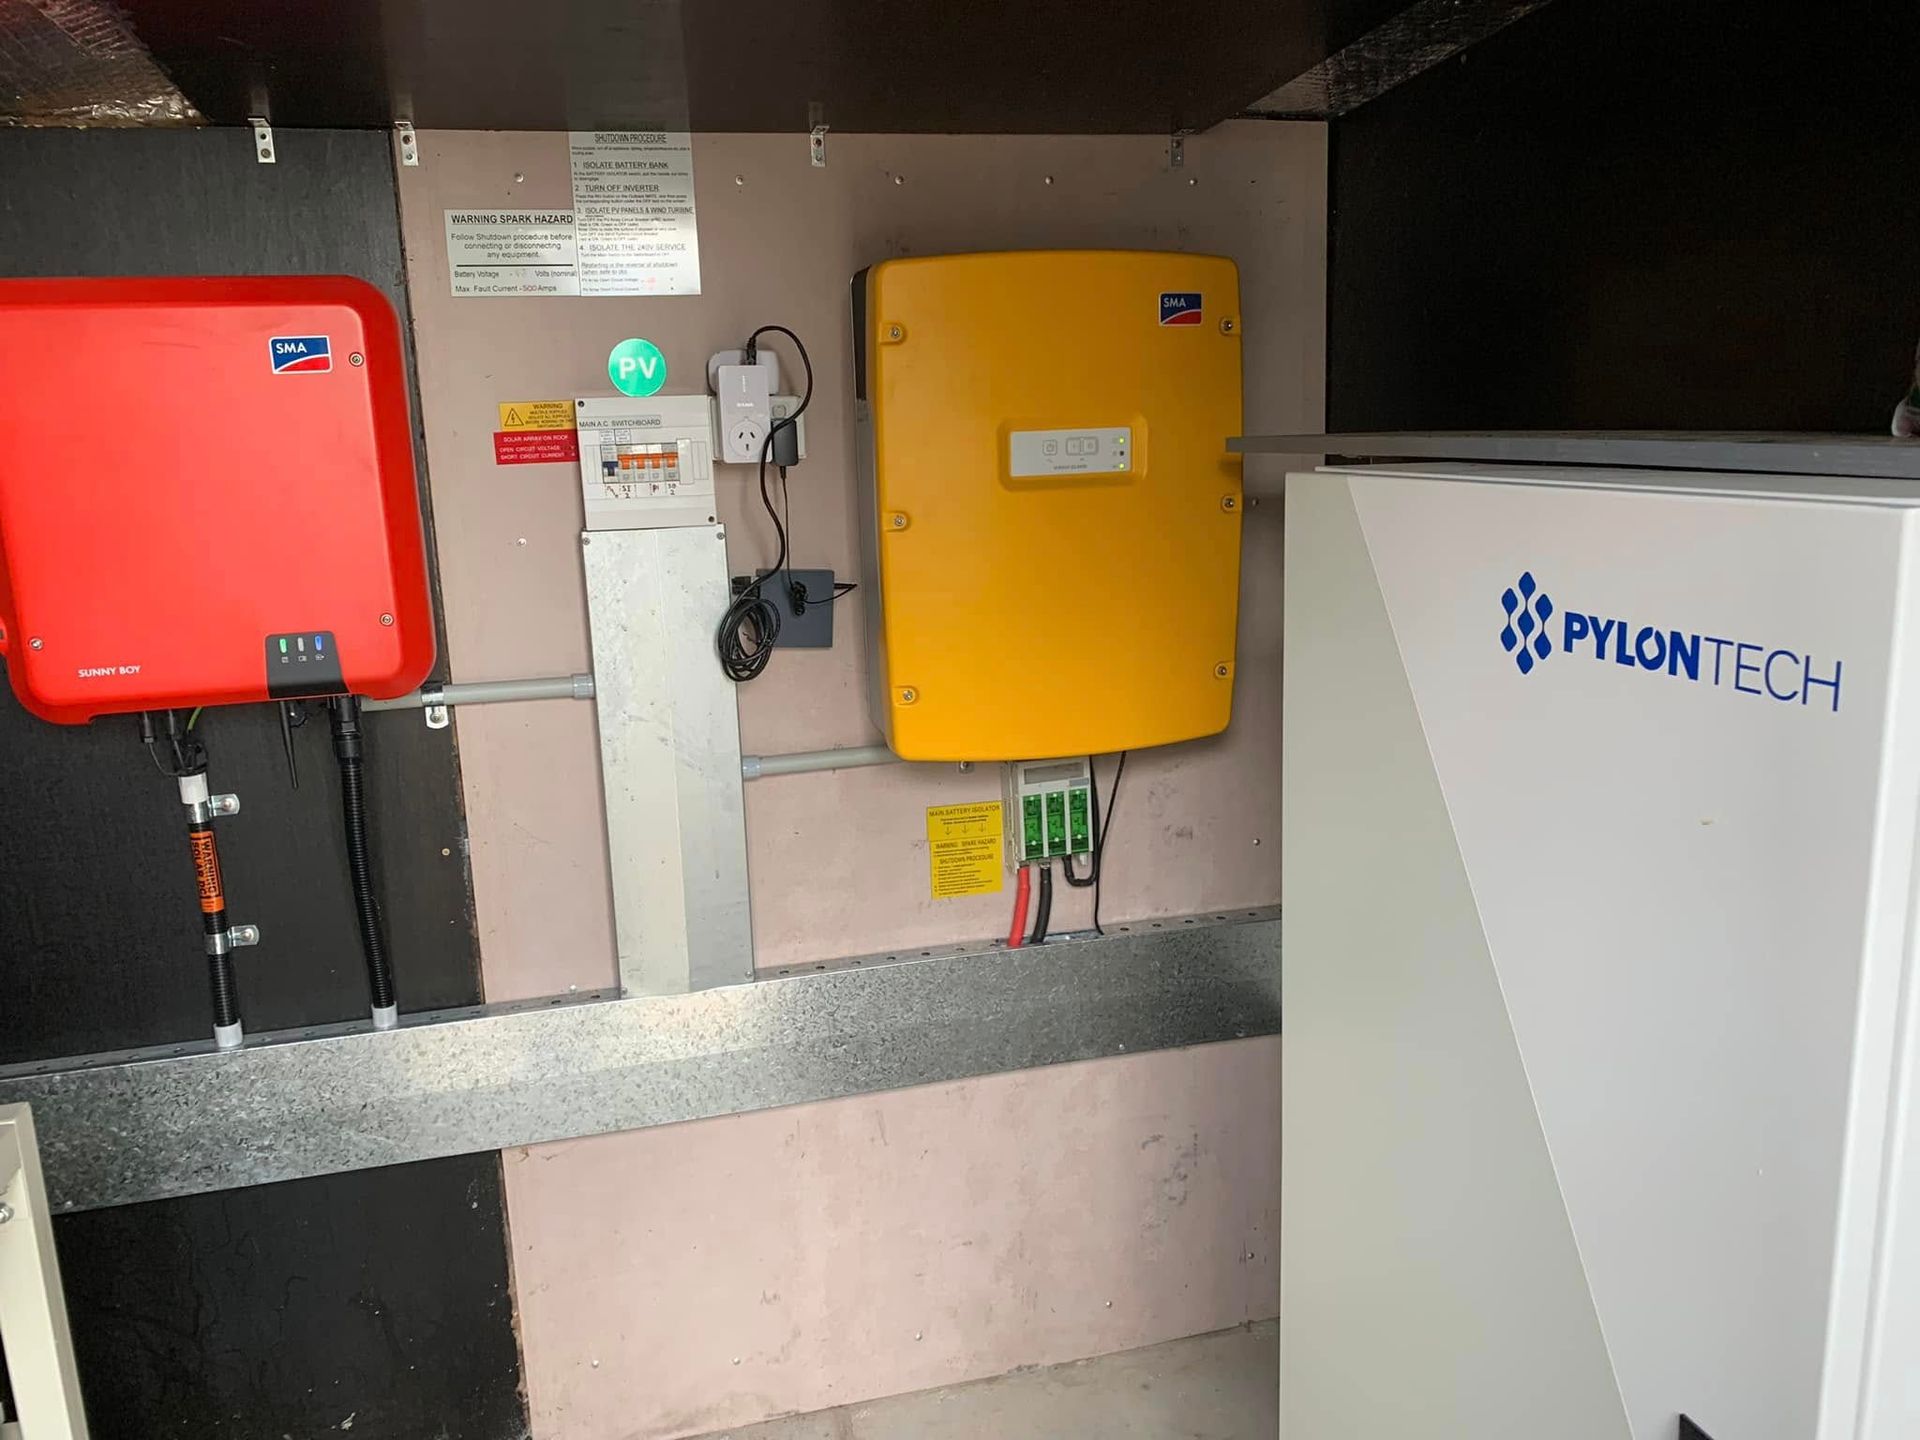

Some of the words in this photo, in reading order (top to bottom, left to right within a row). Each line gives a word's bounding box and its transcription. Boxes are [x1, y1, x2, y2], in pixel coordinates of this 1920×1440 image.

[594, 134, 630, 143] SHUTDOWN
[630, 134, 667, 143] PROCEDURE
[451, 215, 497, 223] WARNING
[499, 215, 532, 223] SPARK
[534, 215, 573, 223] HAZARD
[513, 233, 548, 242] procedure
[464, 243, 503, 251] connecting
[513, 242, 561, 251] disconnecting
[656, 243, 687, 251] SERVICE
[454, 271, 476, 279] Battery
[477, 271, 499, 279] Voltage
[538, 285, 557, 293] Amps
[1163, 297, 1186, 308] SMA
[276, 342, 307, 354] SMA
[619, 357, 657, 380] PV
[611, 418, 661, 427] SWITCHBOARD
[1563, 611, 1842, 712] PYLONTECH
[78, 667, 117, 678] SUNNY
[119, 665, 141, 675] BOY
[945, 807, 971, 815] BATTERY
[971, 804, 1000, 813] ISOLATOR
[201, 840, 217, 894] WARNING
